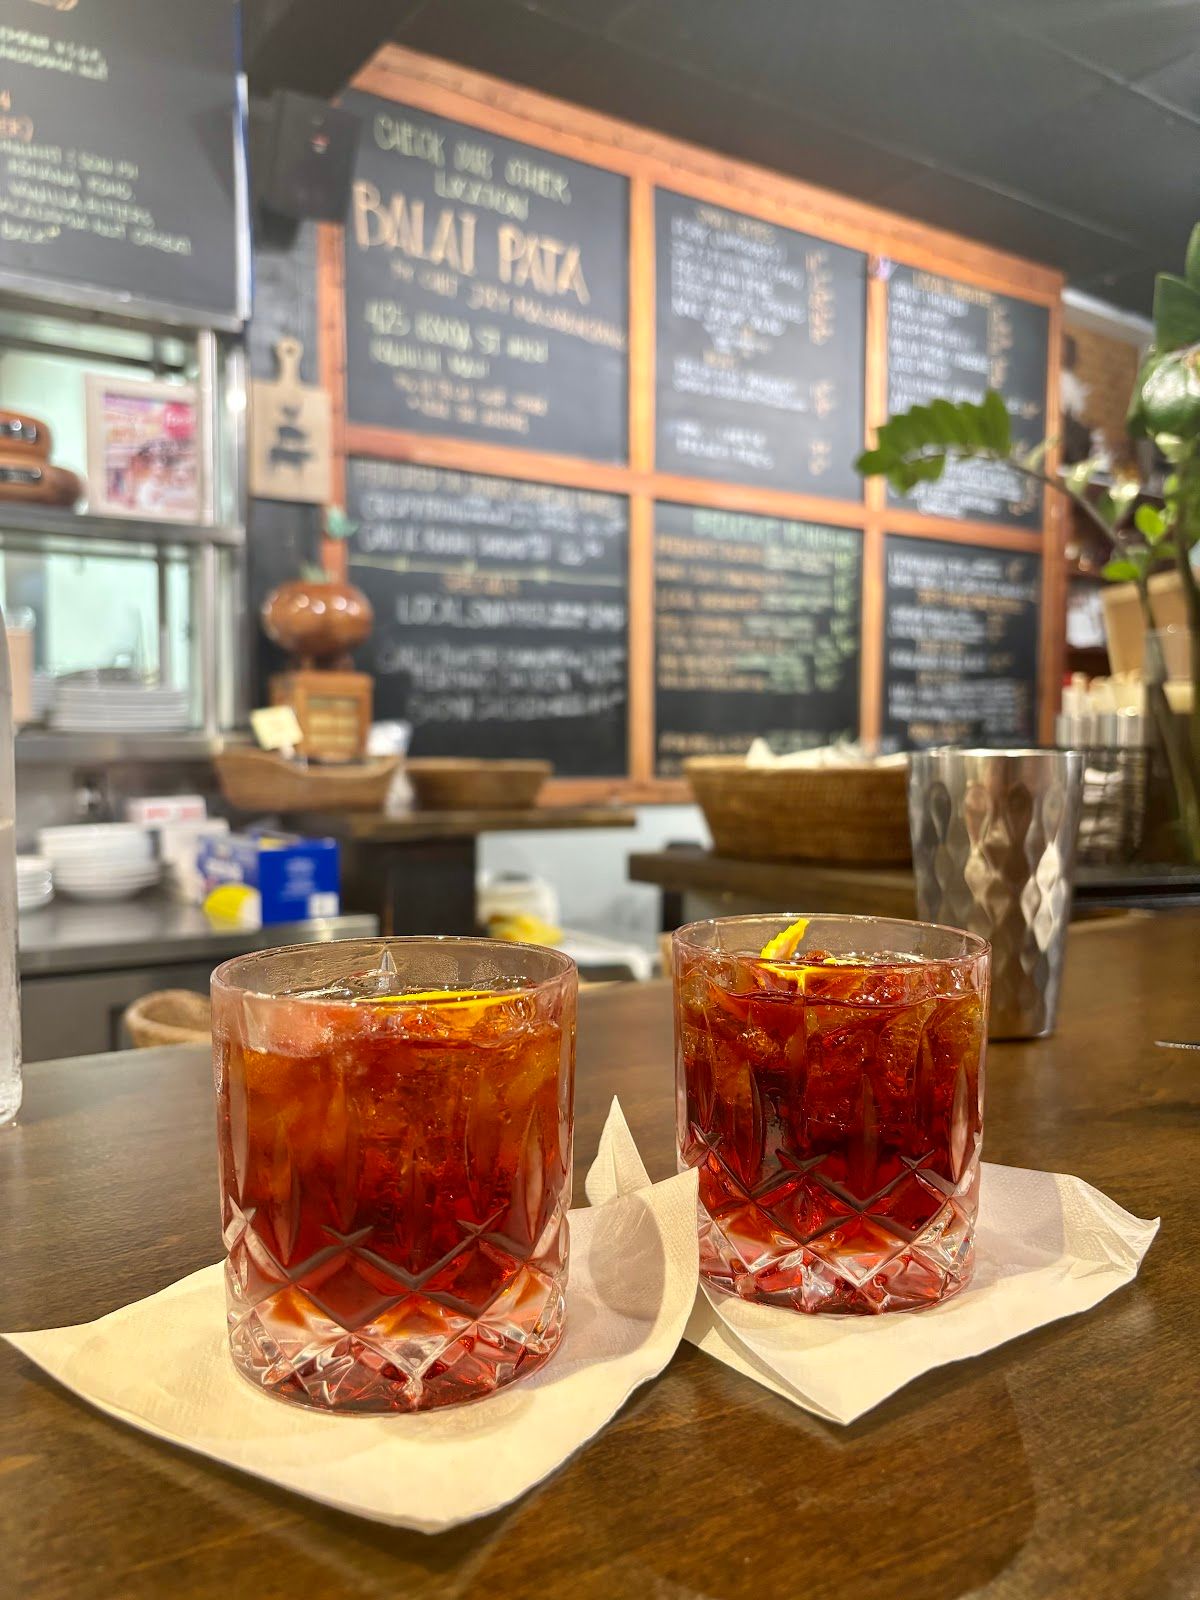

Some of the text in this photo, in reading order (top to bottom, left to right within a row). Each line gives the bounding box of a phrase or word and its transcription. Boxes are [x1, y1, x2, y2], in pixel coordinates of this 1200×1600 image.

[374, 113, 446, 168] CHECK
[352, 177, 477, 277] BALAI
[498, 222, 592, 306] PATA
